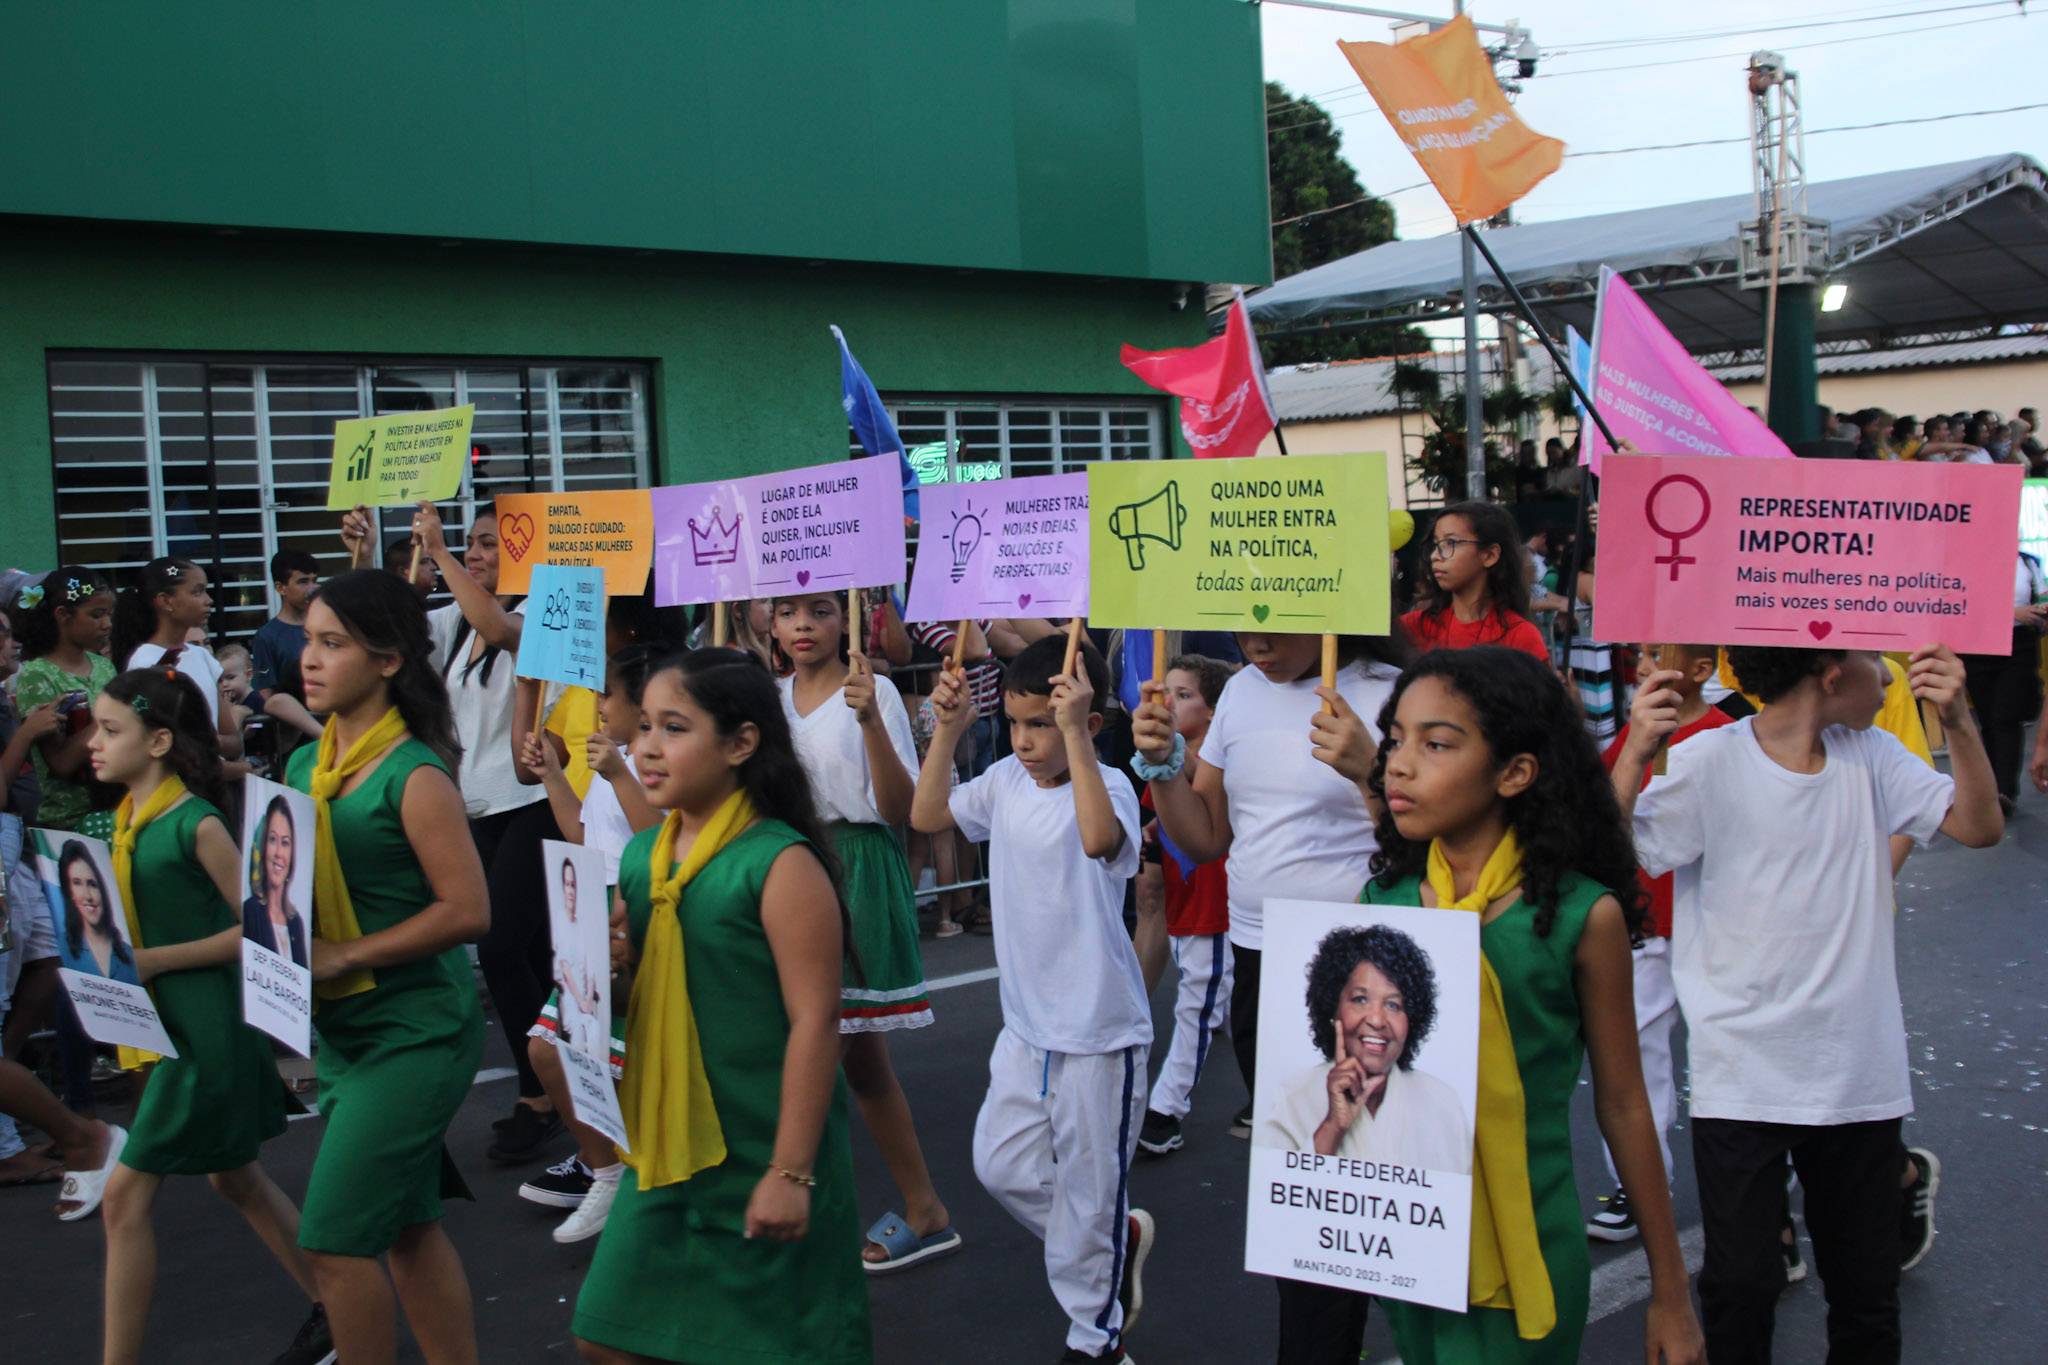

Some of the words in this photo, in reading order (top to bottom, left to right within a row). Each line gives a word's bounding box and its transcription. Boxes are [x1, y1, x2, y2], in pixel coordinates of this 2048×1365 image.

[1597, 386, 1614, 406] AIS
[1614, 397, 1664, 432] JUSTIÇA
[1626, 378, 1693, 421] MULHERES
[387, 424, 413, 436] INVESTIR
[414, 424, 425, 434] EM
[394, 455, 418, 466] FUTURO
[419, 452, 442, 463] MELHOR
[380, 471, 396, 481] PARA
[761, 486, 796, 504] LUGAR
[799, 483, 812, 498] DE
[815, 476, 859, 496] MULHER
[1211, 480, 1282, 501] QUANDO
[1287, 479, 1325, 497] UMA
[762, 508, 768, 524] É
[771, 506, 799, 523] ONDE
[802, 503, 822, 519] ELA
[1005, 497, 1061, 515] MULHERES
[1210, 510, 1278, 528] MULHER
[1284, 508, 1337, 527] ENTRA
[1739, 497, 1972, 523] REPRESENTATIVIDADE
[548, 521, 582, 534] DIÁLOGO
[583, 522, 588, 533] E
[589, 522, 626, 534] CUIDADO:
[762, 528, 802, 546] QUISER,
[804, 519, 860, 539] INCLUSIVE
[1002, 520, 1039, 536] NOVAS
[1041, 518, 1078, 535] IDEIAS,
[548, 541, 578, 552] MARCAS
[580, 541, 594, 551] DAS
[595, 540, 633, 552] MULHERES
[762, 552, 778, 565] NA
[780, 544, 832, 564] POLÍTICA!
[997, 541, 1054, 560] SOLUÇÕES
[1056, 541, 1064, 555] E
[1210, 540, 1233, 557] NA
[1238, 535, 1318, 560] POLÍTICA,
[1738, 529, 1874, 556] IMPORTA!
[992, 562, 1073, 579] PERSPECTIVAS!
[1196, 569, 1245, 591] todas
[1251, 568, 1343, 598] avançam!
[1736, 566, 1777, 584] Mais
[1782, 568, 1862, 586] mulheres
[1868, 574, 1890, 587] na
[1895, 572, 1967, 592] política,
[1735, 592, 1776, 609] mais
[1780, 596, 1829, 610] vozes
[1834, 596, 1888, 612] sendo
[1893, 598, 1967, 616] ouvidas!
[271, 958, 302, 987] FEDERAL
[79, 978, 132, 998] SENADORA
[274, 980, 309, 1016] BARROS
[70, 990, 120, 1011] SIMONE
[119, 1001, 158, 1021] TEBET
[1286, 1151, 1331, 1175] DEP.
[1338, 1158, 1433, 1188] FEDERAL
[1270, 1182, 1401, 1223] BENEDITA
[1409, 1202, 1446, 1230] DA
[1318, 1226, 1394, 1260] SILVA
[1293, 1258, 1352, 1278] MANTADO
[1355, 1268, 1381, 1283] 2023
[1391, 1275, 1418, 1289] 2027
